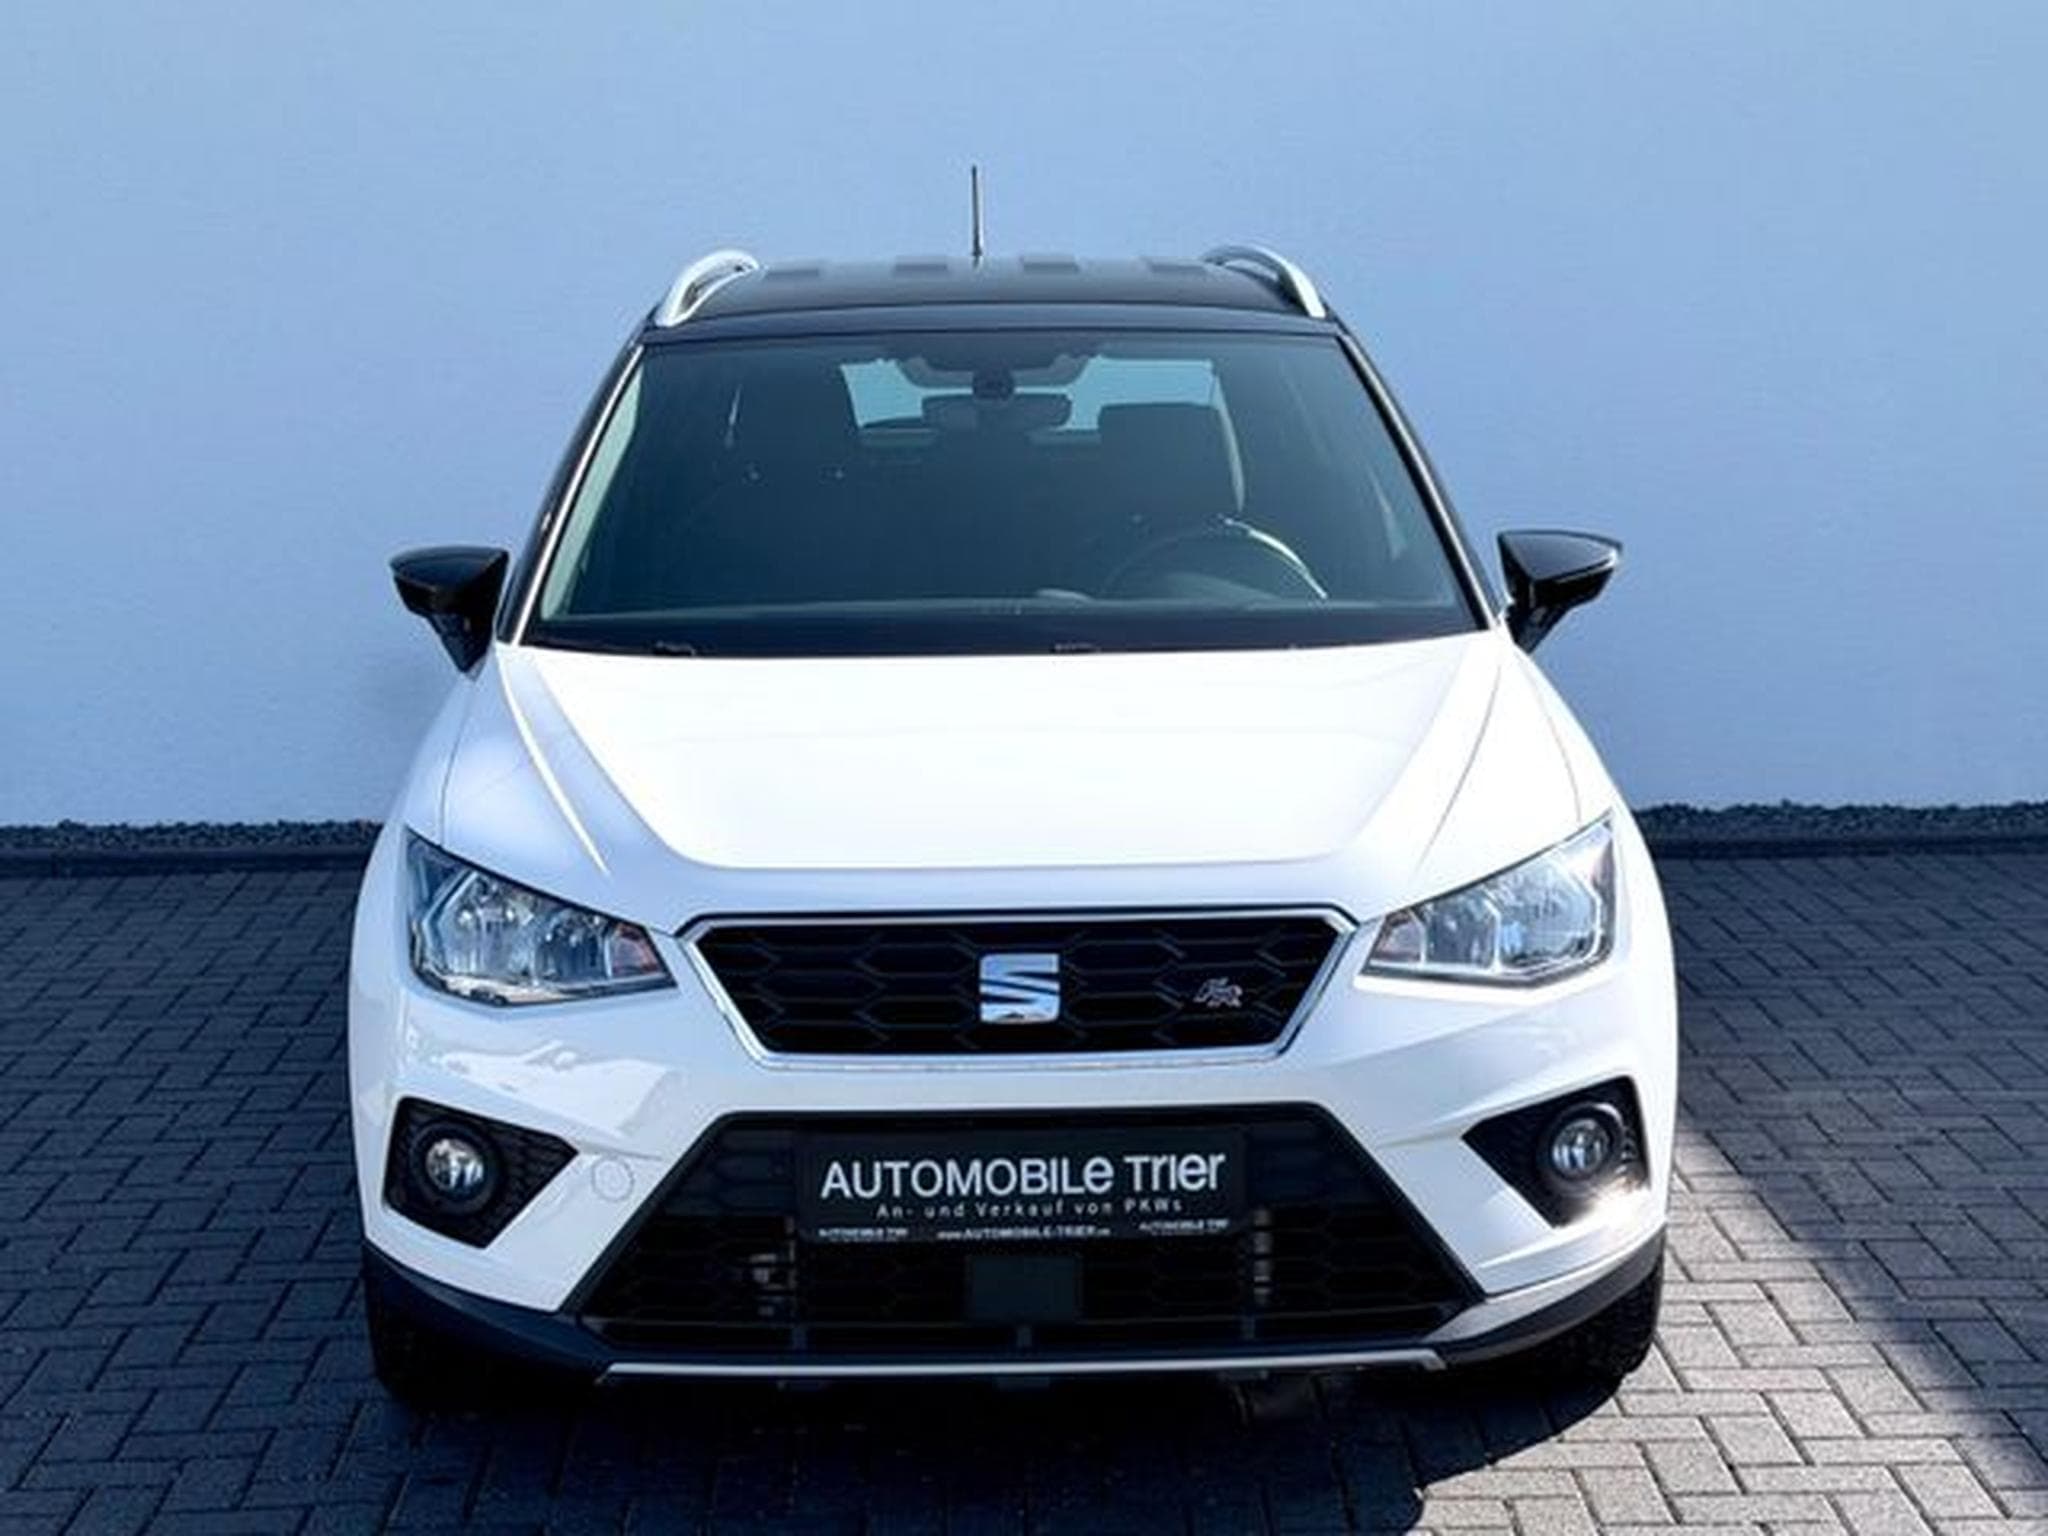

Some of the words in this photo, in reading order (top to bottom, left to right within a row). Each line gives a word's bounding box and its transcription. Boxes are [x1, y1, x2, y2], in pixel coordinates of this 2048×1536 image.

[876, 1203, 914, 1219] An-
[924, 1201, 965, 1218] und
[974, 1199, 1063, 1217] Verkauf
[1073, 1201, 1113, 1214] von
